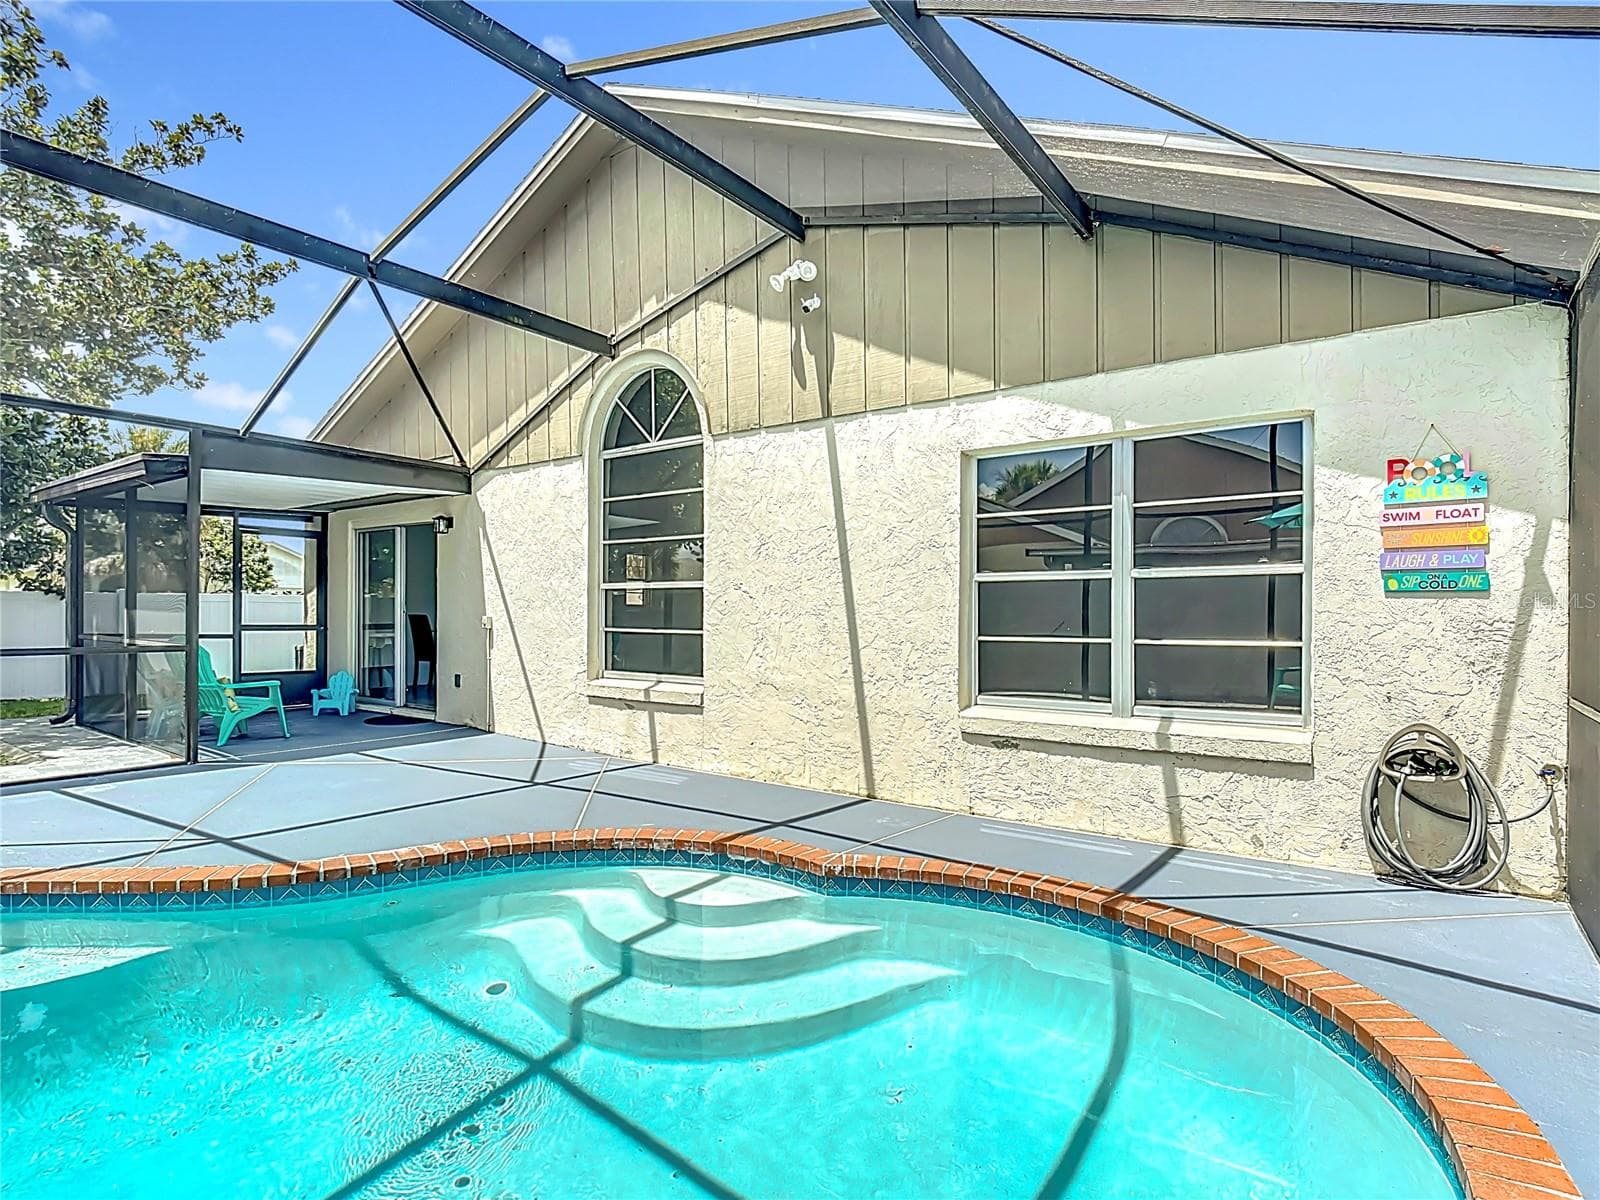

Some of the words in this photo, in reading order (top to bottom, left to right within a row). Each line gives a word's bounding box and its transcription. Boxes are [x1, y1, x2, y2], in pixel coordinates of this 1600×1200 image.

[1387, 449, 1477, 486] POOL
[1404, 483, 1467, 500] RULES
[1382, 511, 1420, 522] SWIM
[1435, 507, 1480, 520] FLOAT
[1411, 529, 1465, 545] SUNSHINE
[1384, 554, 1426, 568] LAUGH
[1428, 553, 1440, 567] &
[1443, 552, 1479, 564] PLAY
[1401, 575, 1421, 588] SIP
[1418, 580, 1458, 590] COLD
[1459, 574, 1486, 588] ONE
